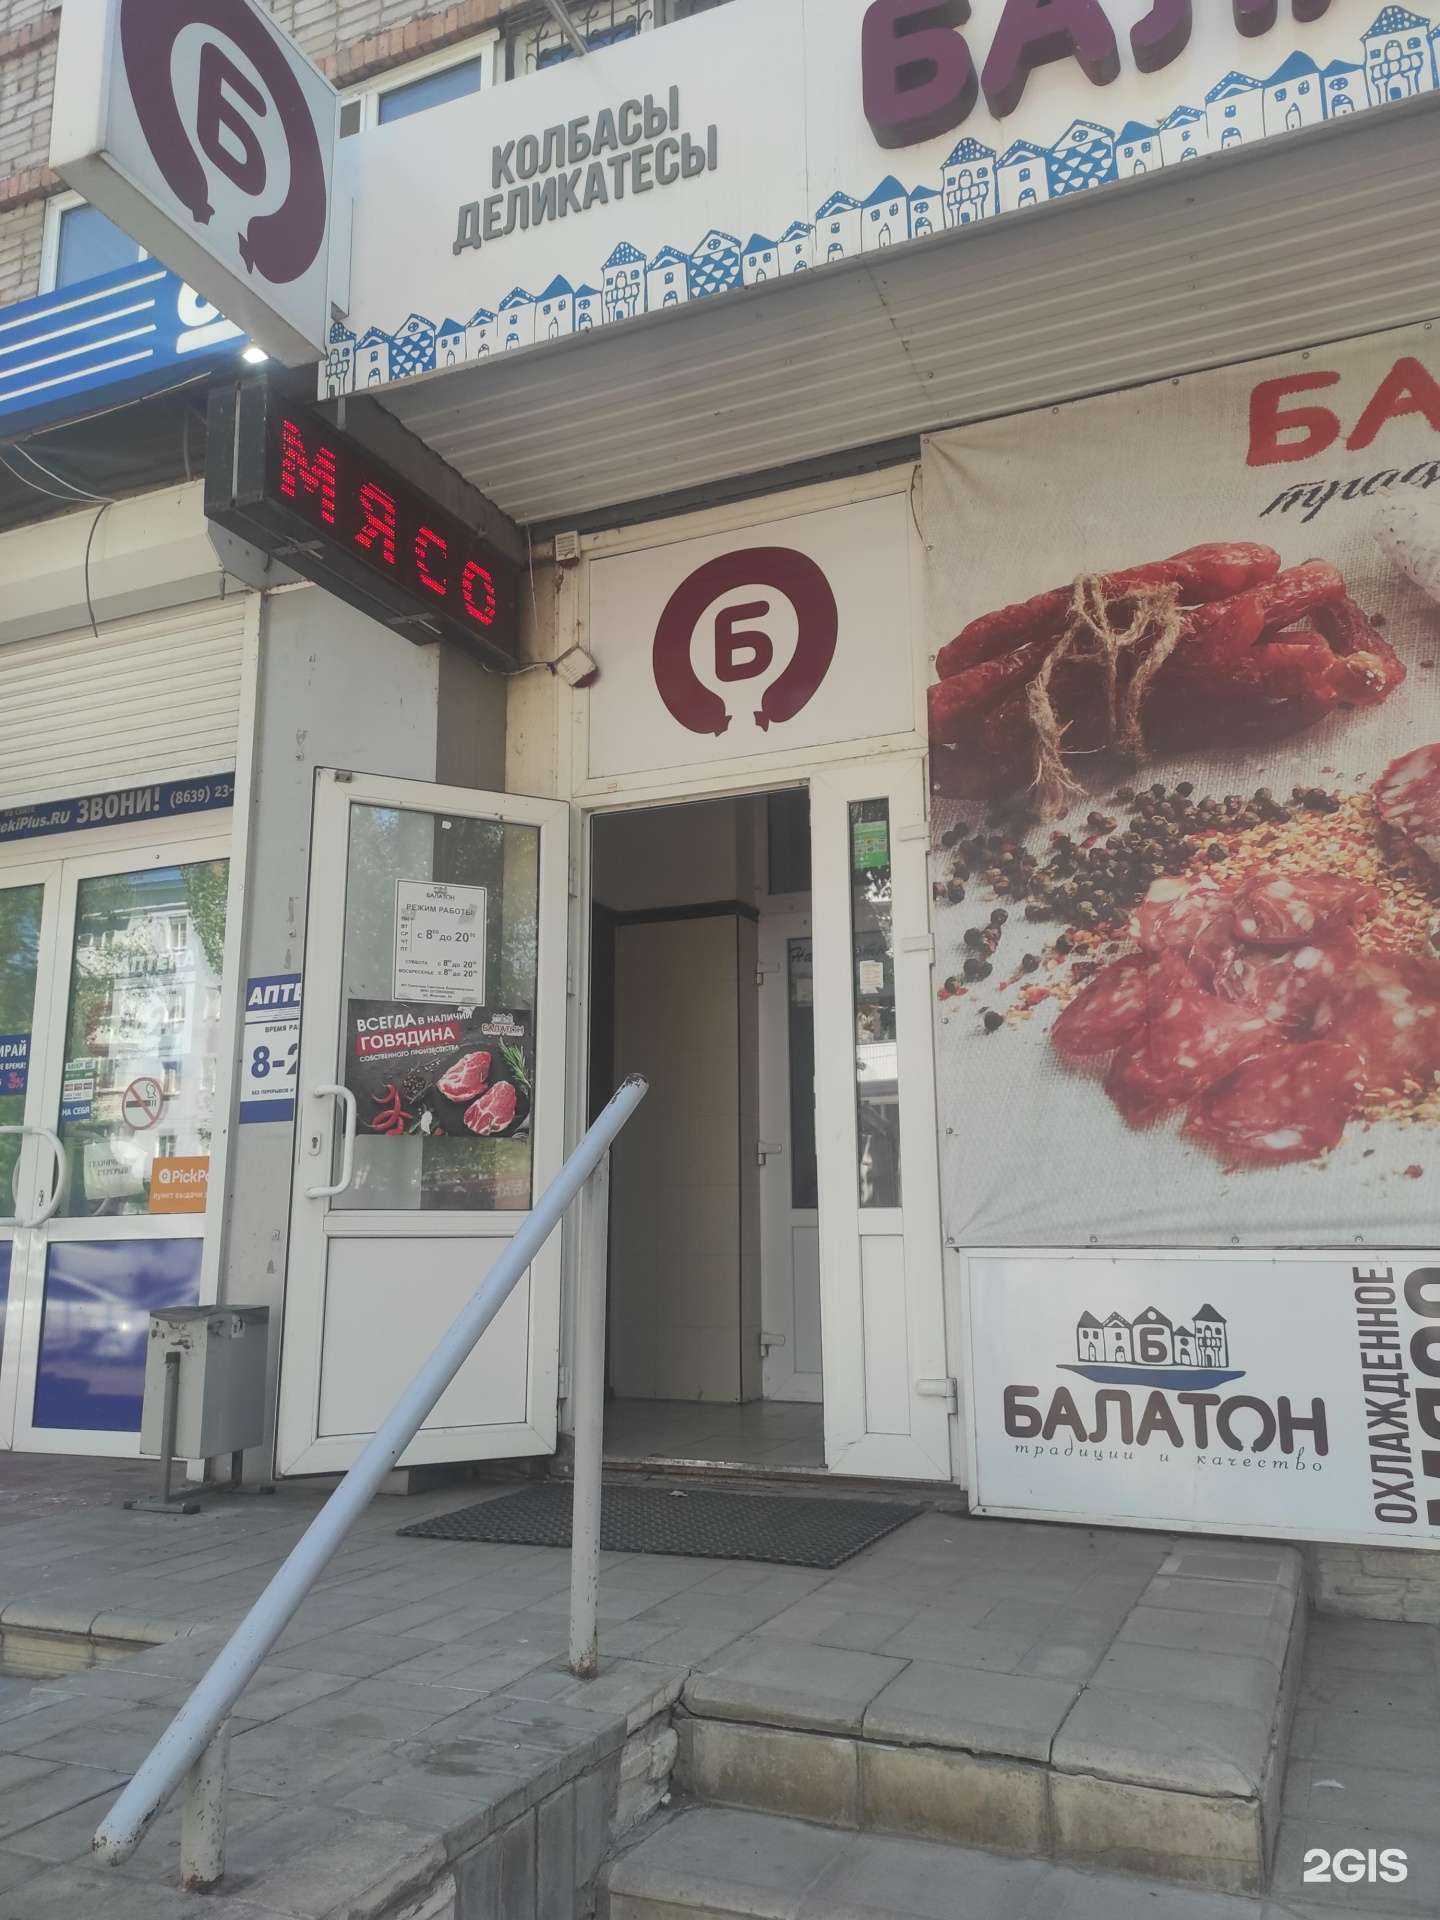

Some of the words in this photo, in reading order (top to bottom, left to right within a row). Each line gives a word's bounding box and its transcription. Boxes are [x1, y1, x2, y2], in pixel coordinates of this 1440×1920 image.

[862, 0, 1331, 149] БА
[491, 84, 679, 189] КОЛБАСЫ
[452, 124, 718, 256] ДЕЛИКАТЕСЫ
[1246, 356, 1440, 467] БА
[280, 418, 496, 627] МЯСО
[714, 600, 774, 683] Б
[0, 811, 71, 832] ekiPlus.RU
[76, 787, 161, 823] ЗВОНИ!
[169, 785, 211, 809] (8639)
[406, 903, 437, 913] РЕЖИМ
[439, 907, 473, 916] РАБОТЫ
[426, 892, 455, 900] БАЛАТОН
[440, 934, 452, 942] до
[357, 1013, 417, 1032] ВСЕГДА
[427, 1012, 473, 1024] НАЛИЧИИ
[360, 1028, 456, 1051] ГОВЯДИНА
[359, 1050, 410, 1063] СОБСТВЕННОГО
[410, 1044, 460, 1056] ПРОИЗВОДСТВА
[73, 1105, 90, 1115] СЕБЯ
[1139, 1327, 1168, 1363] Б
[1352, 1266, 1418, 1525] ОХЛАЖДЕННОЕ
[1003, 1384, 1329, 1457] БАЛАТОН
[1015, 1435, 1134, 1461] традиции
[1159, 1452, 1169, 1463] и
[1196, 1446, 1323, 1472] качество
